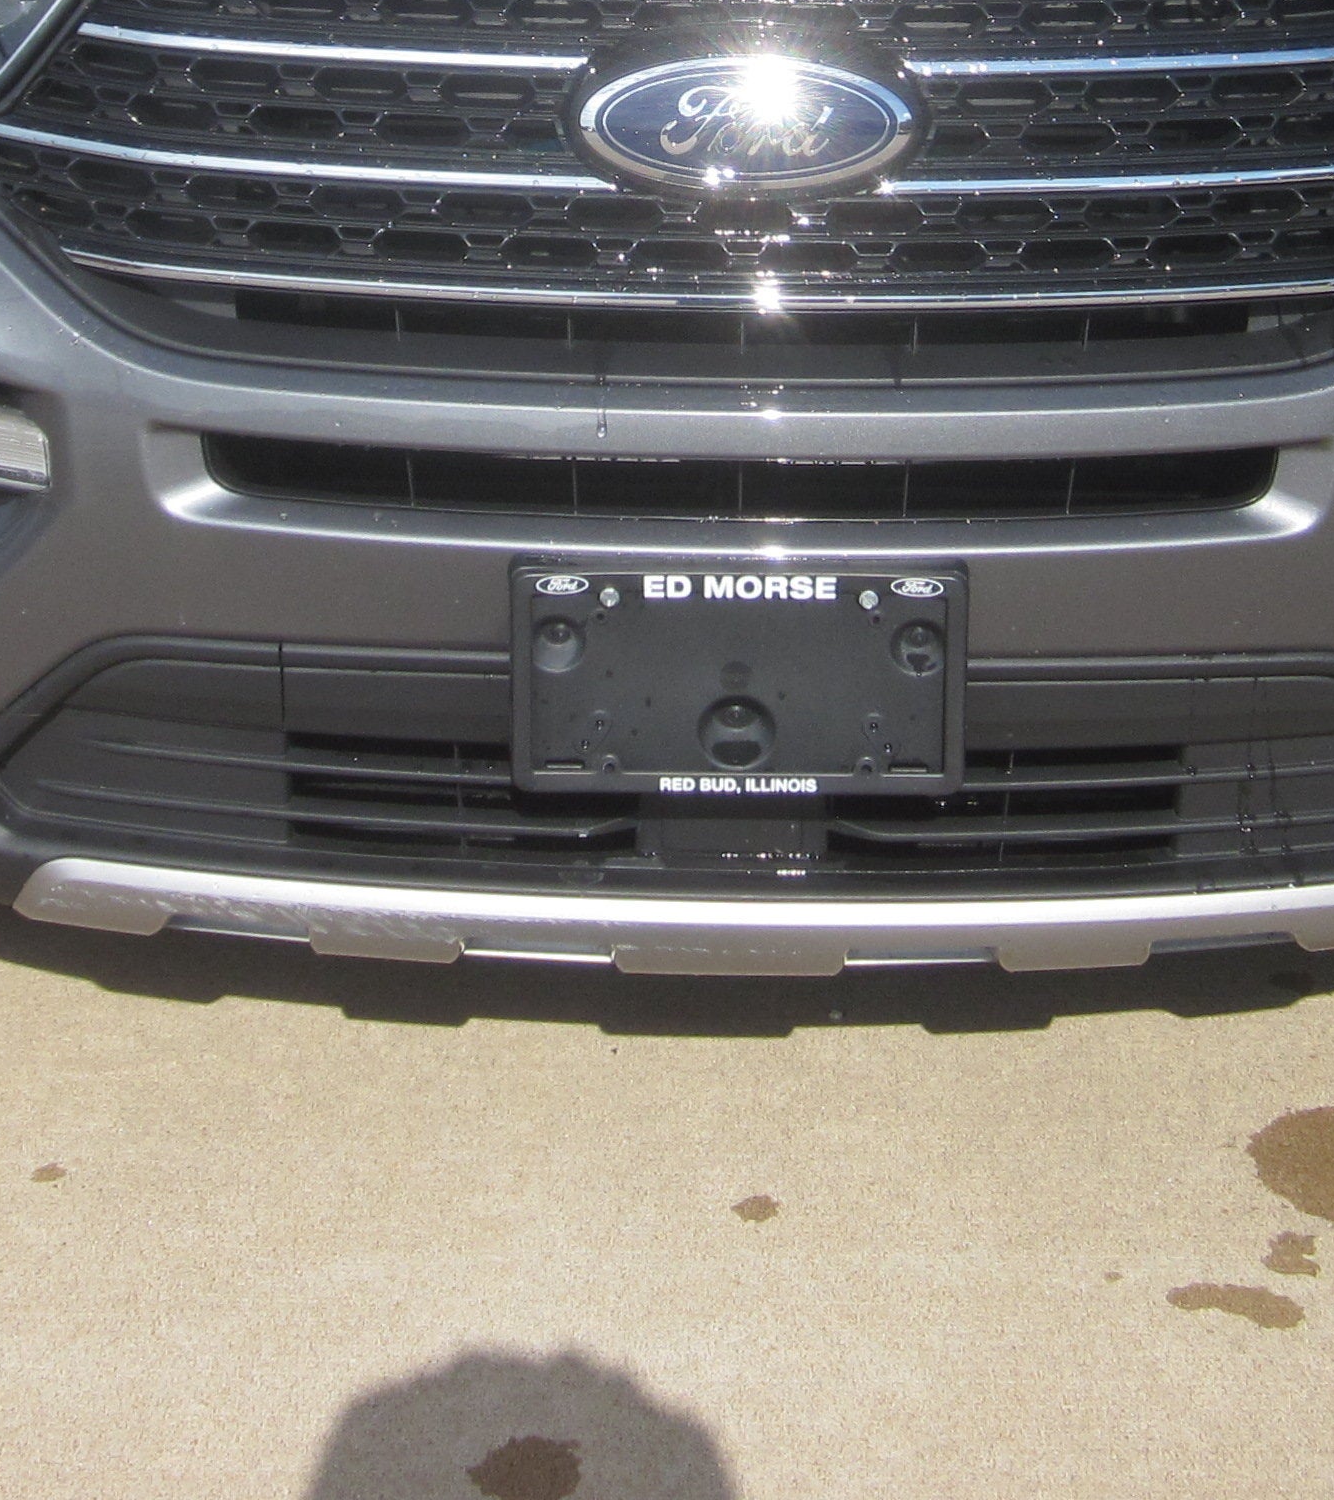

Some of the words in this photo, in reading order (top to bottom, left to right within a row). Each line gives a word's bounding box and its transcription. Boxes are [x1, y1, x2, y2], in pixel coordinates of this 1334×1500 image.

[659, 84, 834, 157] Ford
[546, 579, 578, 593] Ford
[643, 575, 691, 598] ED
[703, 576, 837, 600] MORSE
[901, 580, 933, 595] Ford
[660, 777, 695, 792] RED
[700, 778, 741, 794] BUD,
[745, 778, 817, 793] ILLINOIS
